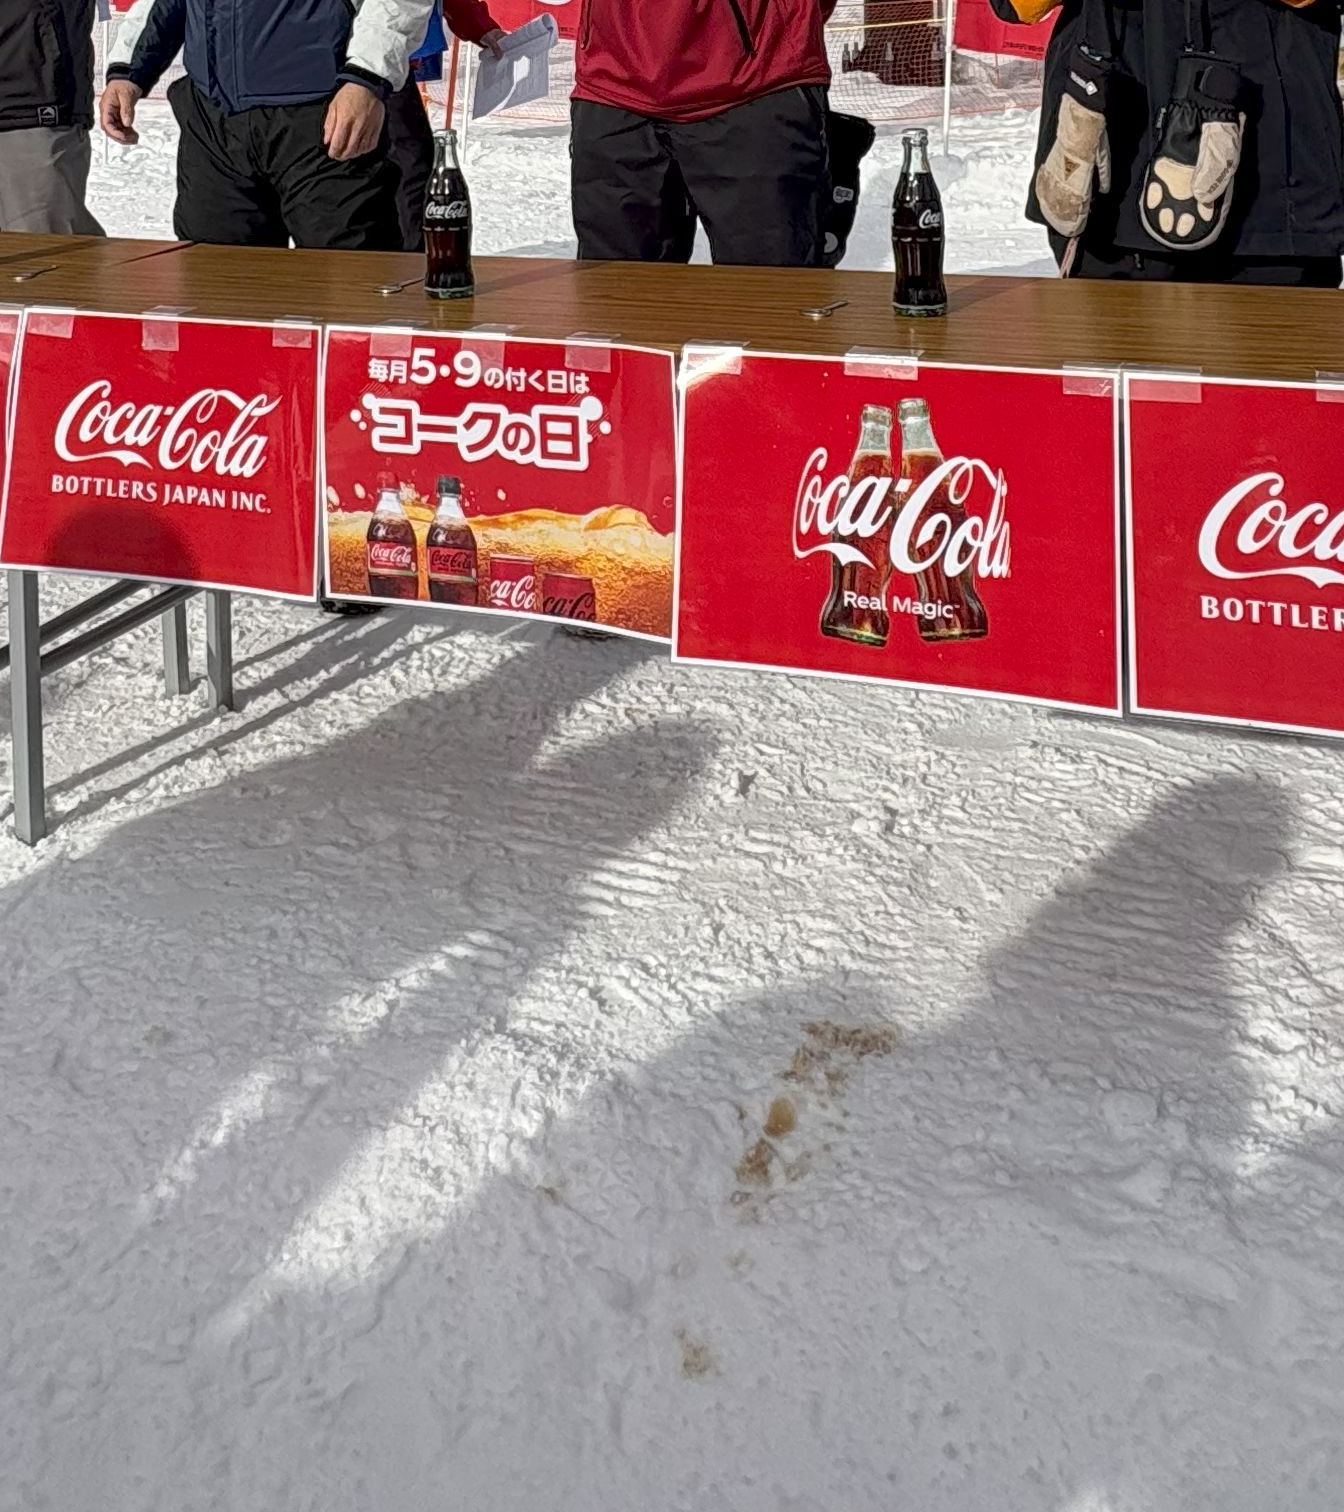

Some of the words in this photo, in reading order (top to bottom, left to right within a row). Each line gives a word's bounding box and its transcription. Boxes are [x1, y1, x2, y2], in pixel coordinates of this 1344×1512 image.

[54, 380, 282, 479] Coca-Cola
[371, 398, 590, 471] コークの日
[51, 474, 157, 503] BOTTLERS
[163, 482, 226, 509] JAPAN
[231, 491, 272, 515] INC.
[792, 446, 1012, 578] Coca-Cola
[843, 590, 888, 612] Real
[893, 595, 955, 619] Magic
